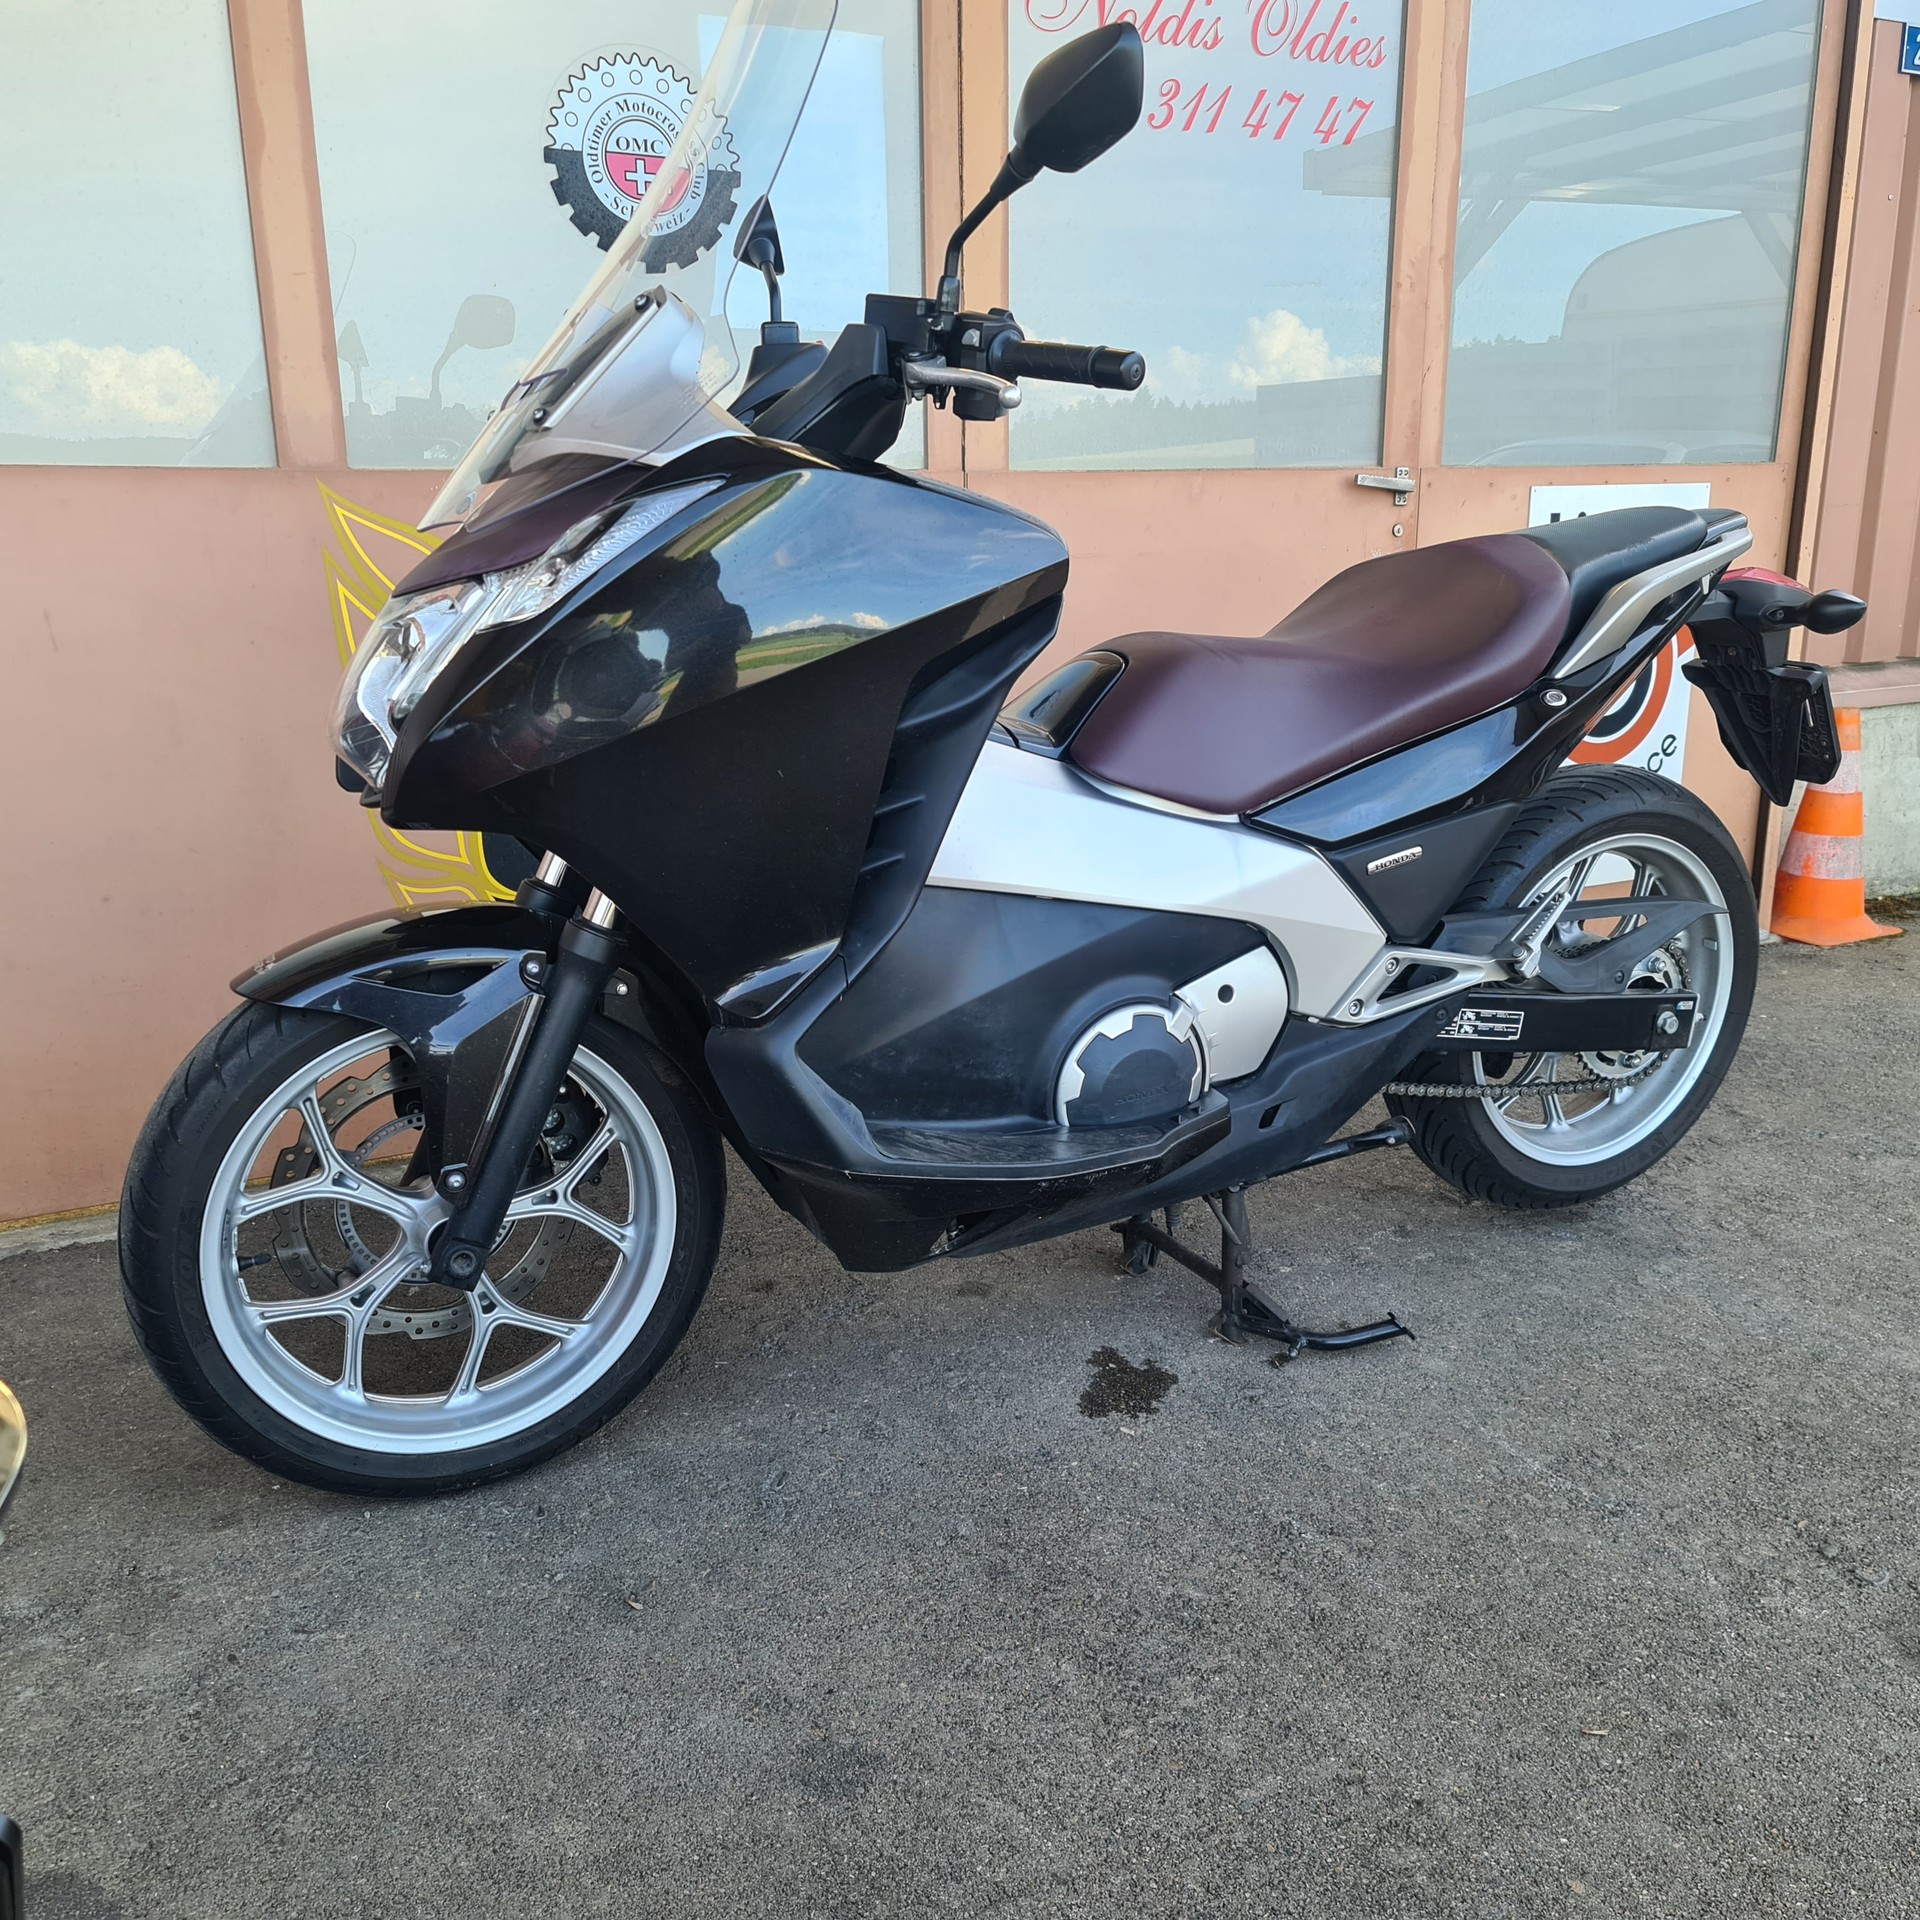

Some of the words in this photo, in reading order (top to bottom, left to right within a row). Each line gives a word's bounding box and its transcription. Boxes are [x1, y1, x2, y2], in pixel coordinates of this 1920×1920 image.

[1247, 0, 1388, 68] Oldies
[1147, 78, 1232, 133] 311
[1242, 89, 1305, 140] 47
[1313, 96, 1375, 146] 47
[586, 109, 612, 184] Oldtimer
[690, 162, 706, 199] Club
[615, 135, 664, 155] OMC
[610, 196, 686, 233] Scweiz
[1374, 852, 1418, 871] HONDA
